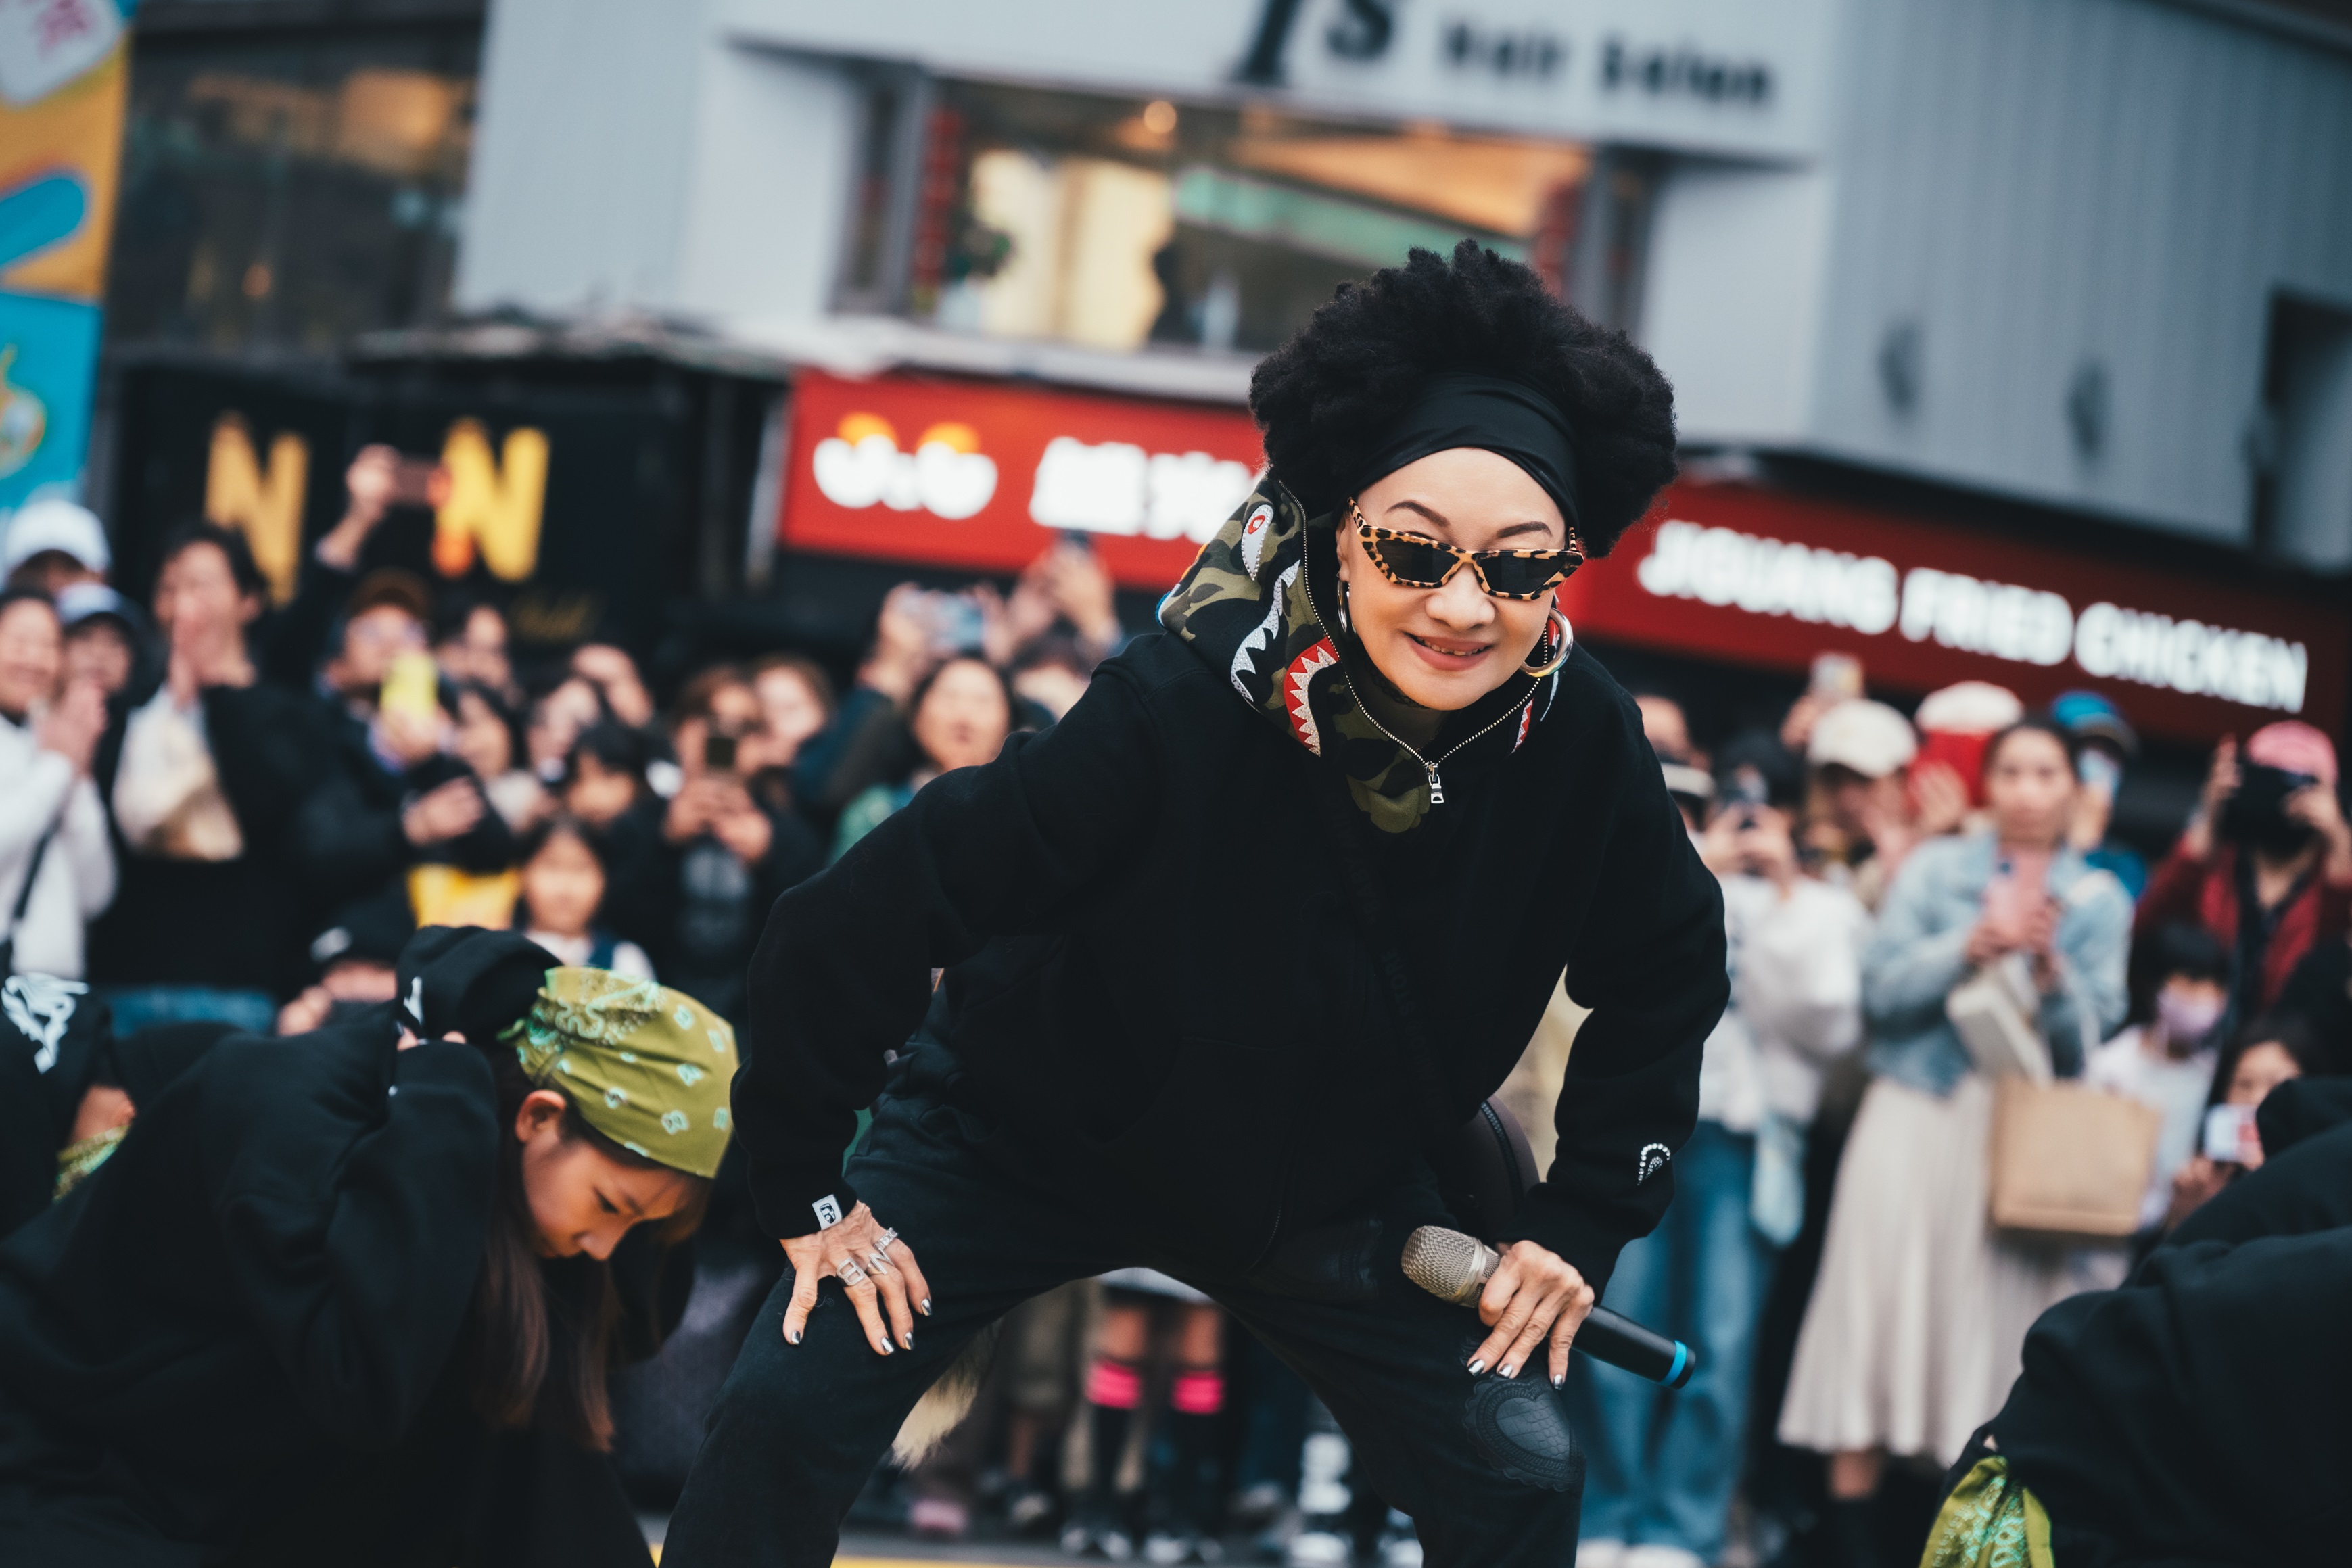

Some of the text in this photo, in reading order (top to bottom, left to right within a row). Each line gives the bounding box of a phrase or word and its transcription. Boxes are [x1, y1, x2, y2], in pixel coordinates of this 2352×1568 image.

[431, 415, 552, 583] N
[1900, 567, 2073, 665] FRIED
[2074, 602, 2308, 713] CHICKEN
[1380, 947, 1417, 1017] STORE
